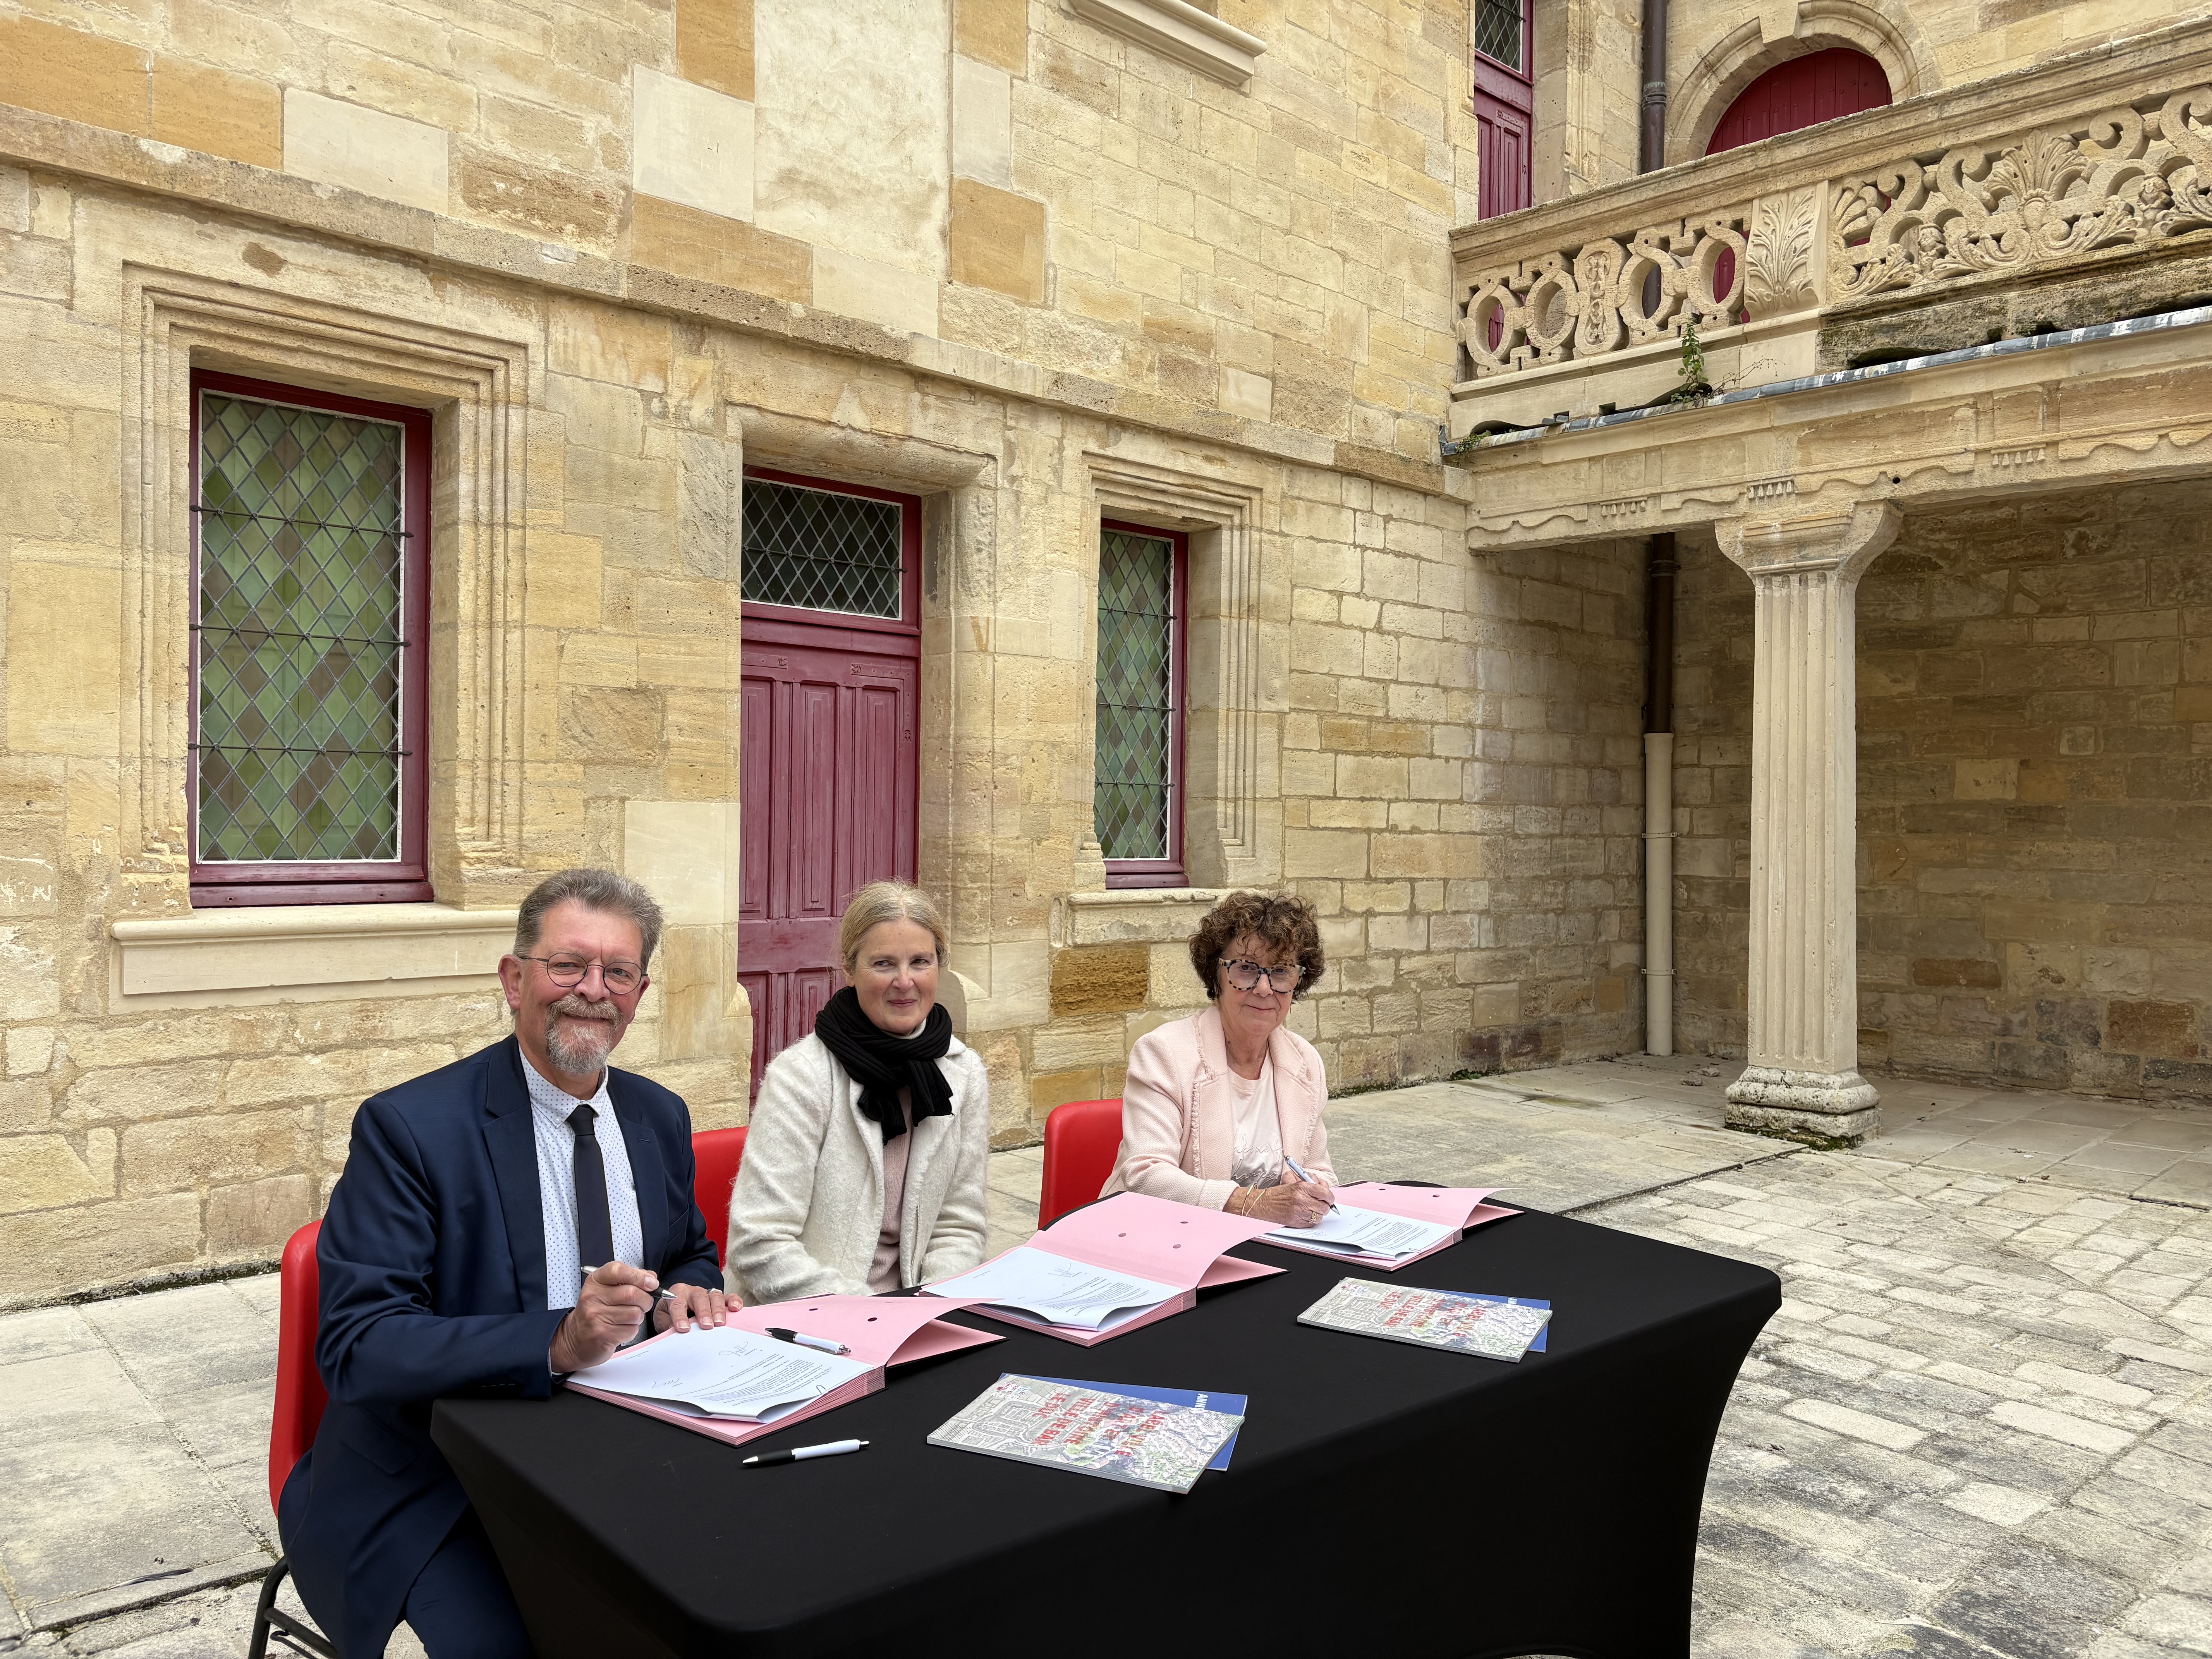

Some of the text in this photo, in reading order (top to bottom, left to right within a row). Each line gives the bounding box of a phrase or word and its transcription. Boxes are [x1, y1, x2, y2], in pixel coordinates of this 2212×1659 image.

[1393, 1309, 1412, 1317] DE
[1400, 1295, 1425, 1309] VILLE
[1030, 1393, 1072, 1419] LE DUC
[1030, 1397, 1096, 1446] VILLE DE BAR
[1113, 1410, 1170, 1457] LABEL VILLE
